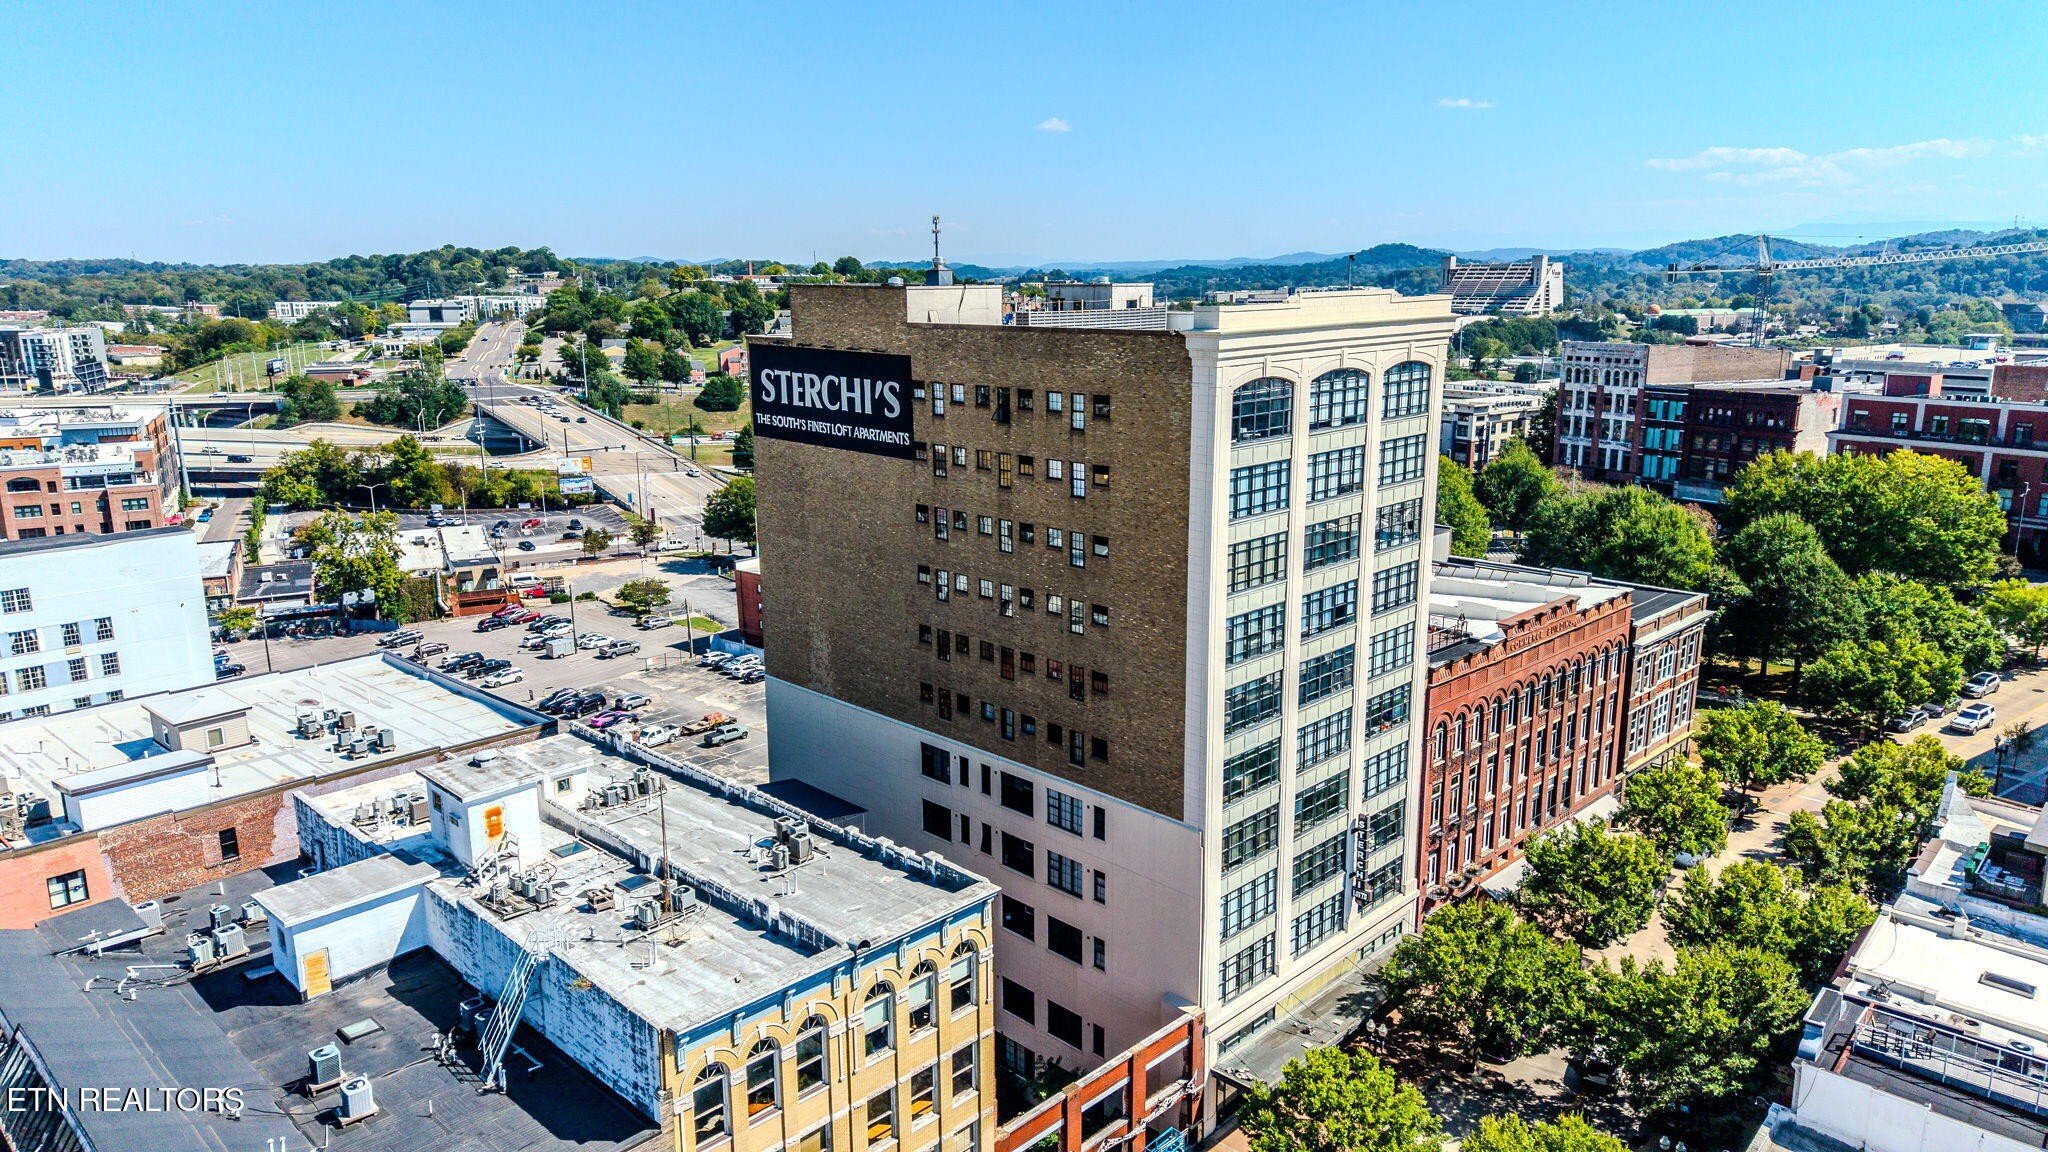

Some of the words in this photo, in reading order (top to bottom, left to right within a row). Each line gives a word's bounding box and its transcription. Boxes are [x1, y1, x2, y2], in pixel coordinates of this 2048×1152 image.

[760, 368, 900, 418] STERCHI'S
[756, 412, 771, 425] THE
[772, 415, 807, 431] SOUTH'S
[807, 419, 831, 434] FINEST
[831, 423, 853, 438] LOFT
[853, 426, 910, 446] APARTMENTS
[1356, 820, 1365, 888] STERCHI
